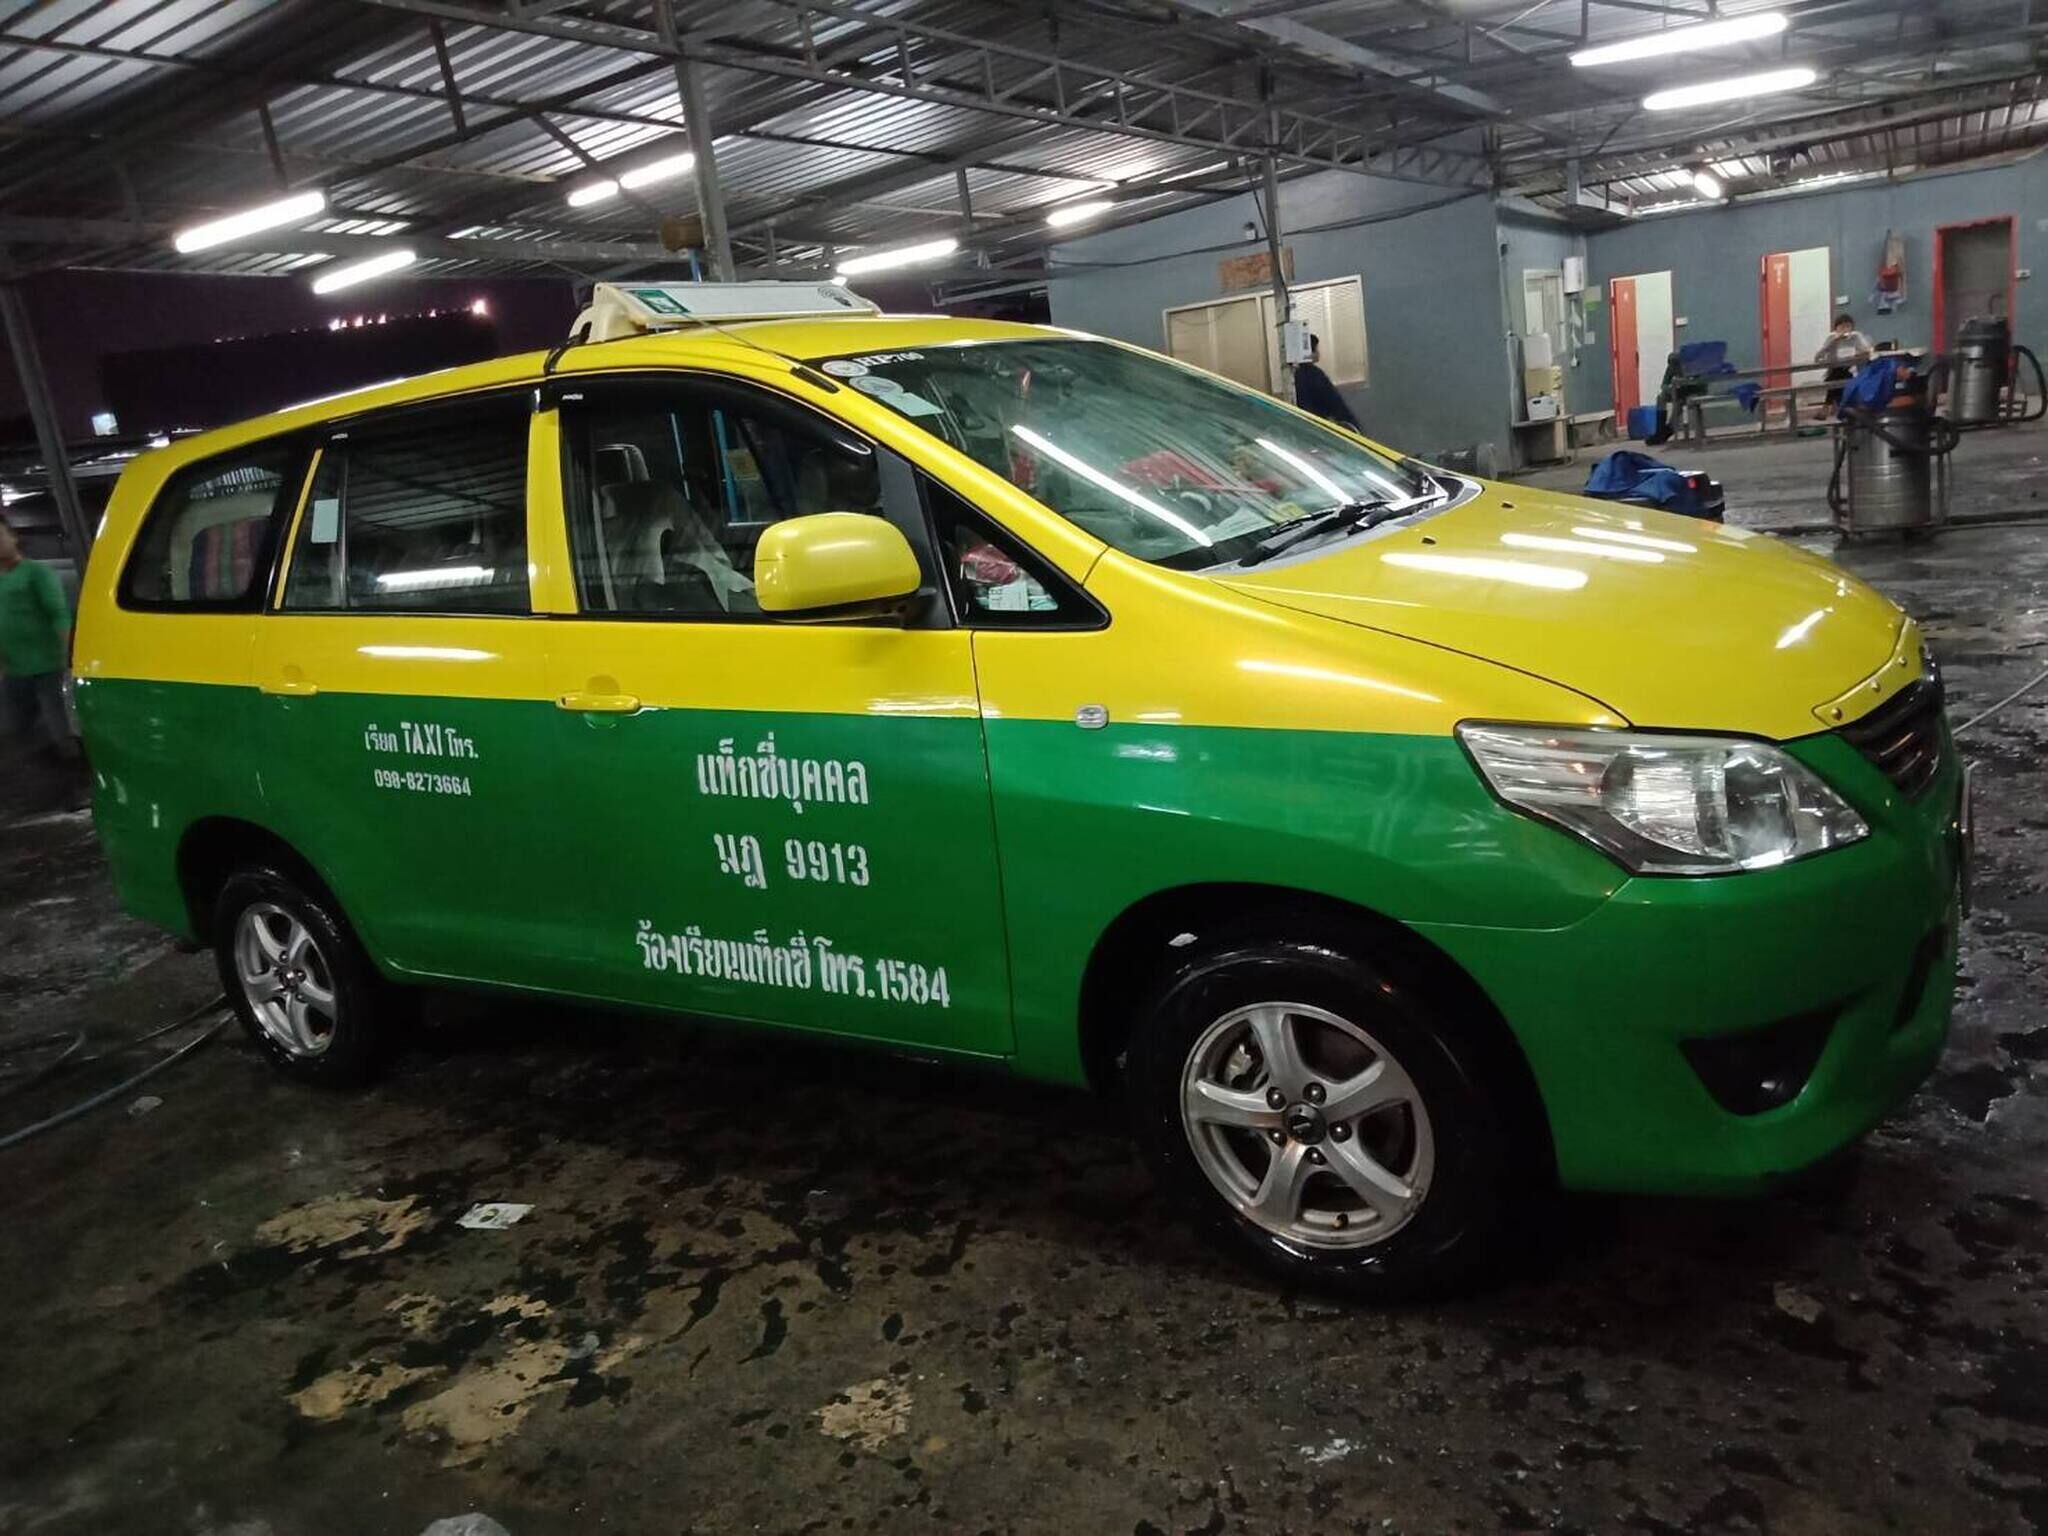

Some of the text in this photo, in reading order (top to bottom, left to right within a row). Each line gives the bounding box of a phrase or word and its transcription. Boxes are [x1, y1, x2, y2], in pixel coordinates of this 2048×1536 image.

[364, 721, 479, 759] เรียก TAXI โทร.
[374, 769, 471, 796] 098-8273664
[697, 731, 869, 814] แท็กซี่บุคคล
[784, 839, 870, 887] 9913
